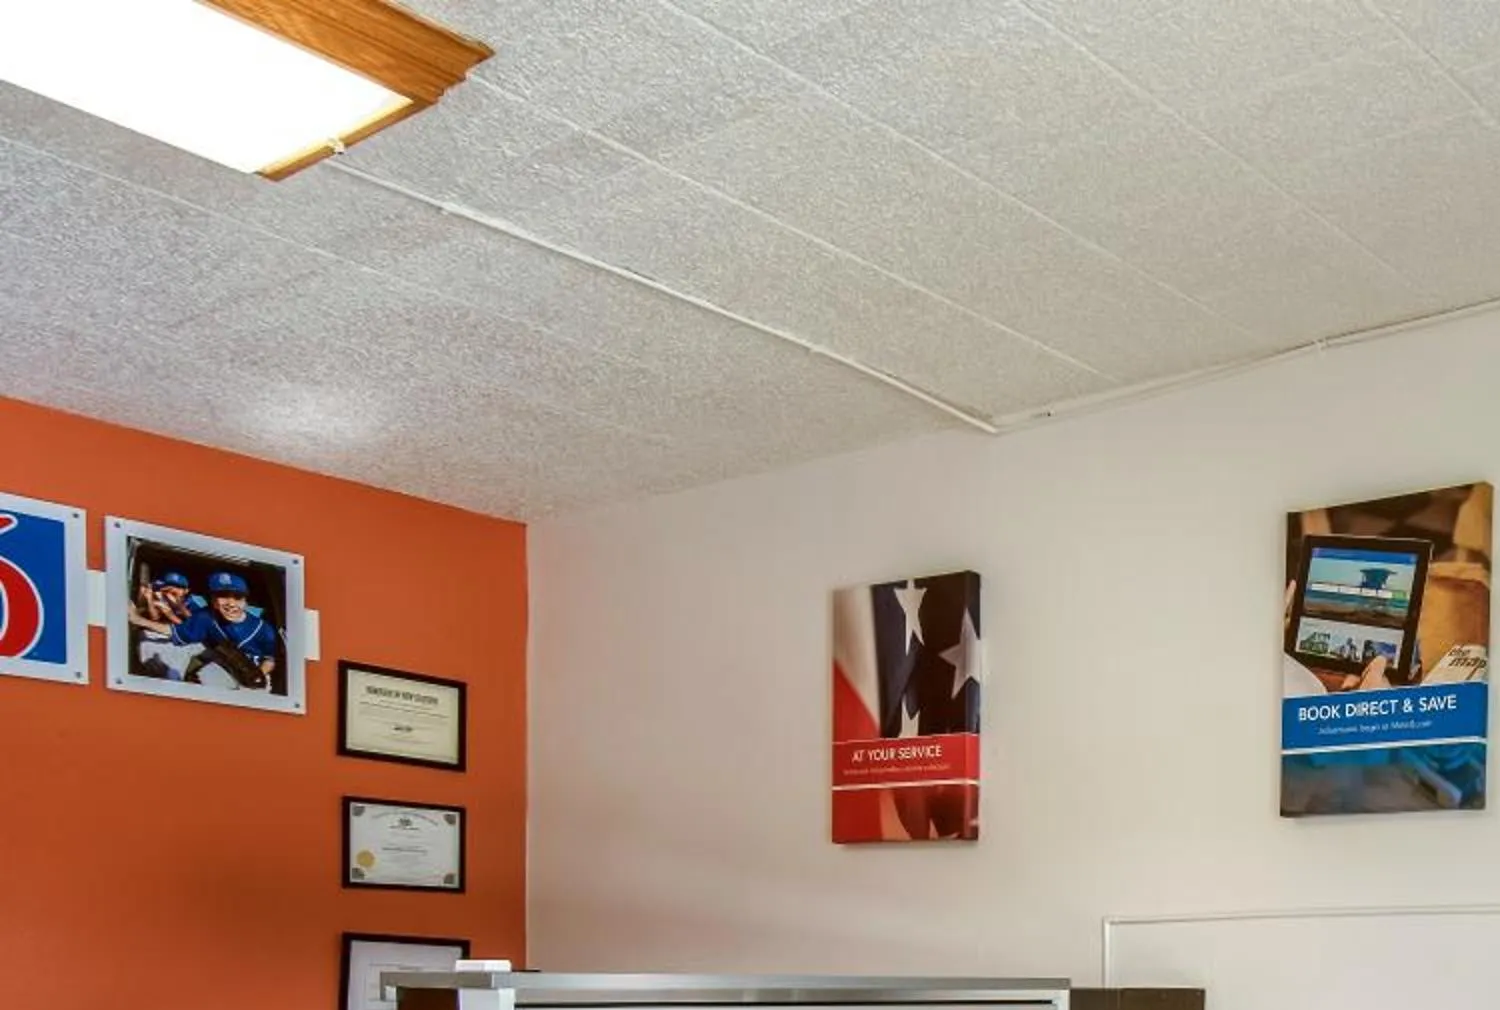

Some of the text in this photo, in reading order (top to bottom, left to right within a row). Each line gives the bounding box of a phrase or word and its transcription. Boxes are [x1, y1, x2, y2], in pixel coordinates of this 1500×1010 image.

[1299, 694, 1457, 721] BOOK DIRECT & SAVE
[851, 744, 943, 763] AT YOUR SERVICE
